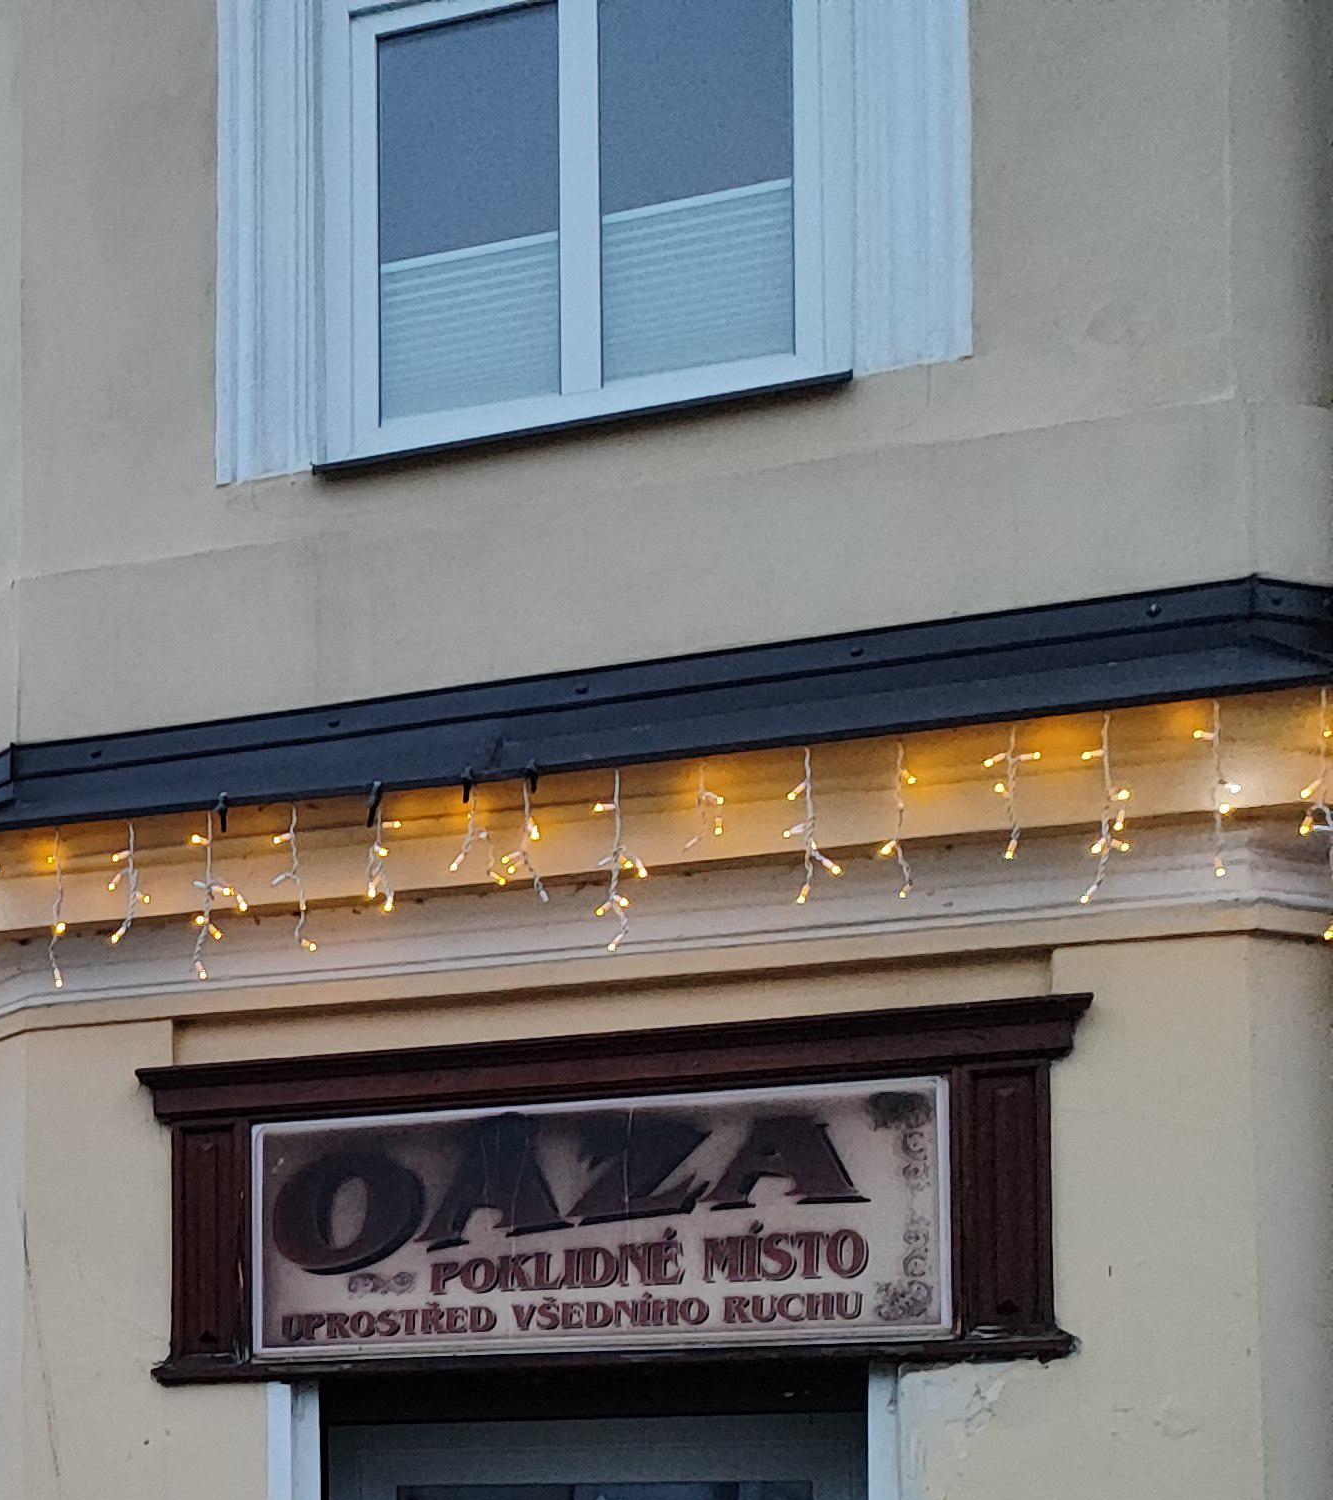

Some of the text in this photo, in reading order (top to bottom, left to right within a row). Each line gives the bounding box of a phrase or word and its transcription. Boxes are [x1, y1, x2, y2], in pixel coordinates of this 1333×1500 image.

[430, 1219, 869, 1295] POKLIDNÉ MÍSTO
[282, 1291, 863, 1341] UPROSTŘED VŠEDNÍHO RUCHU
